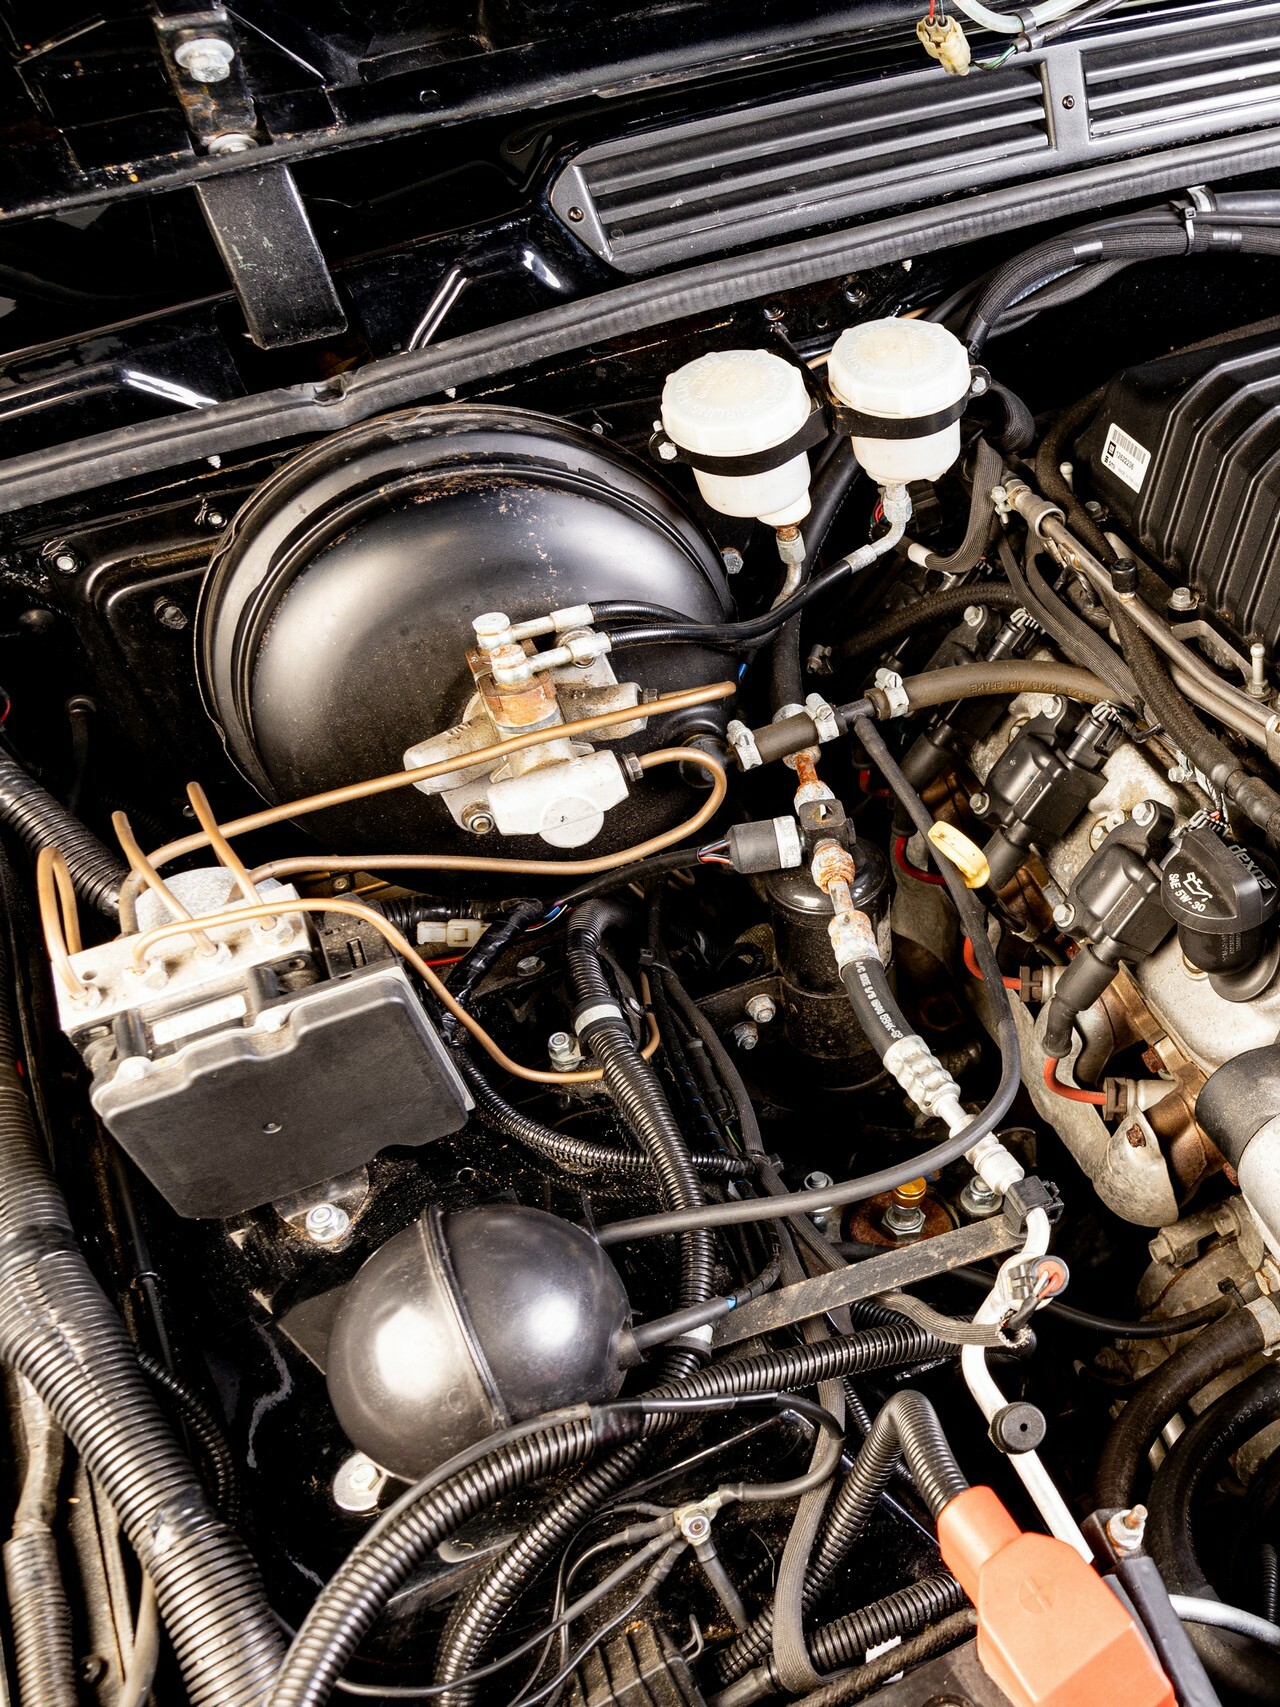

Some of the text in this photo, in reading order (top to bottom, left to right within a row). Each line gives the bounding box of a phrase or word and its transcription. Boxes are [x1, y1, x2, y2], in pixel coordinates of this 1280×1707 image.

[729, 353, 770, 366] ONLY
[970, 680, 1003, 693] BRAKE
[1008, 680, 1025, 691] AIR
[1227, 844, 1277, 891] dexos
[1168, 873, 1207, 912] SAE 5W-30
